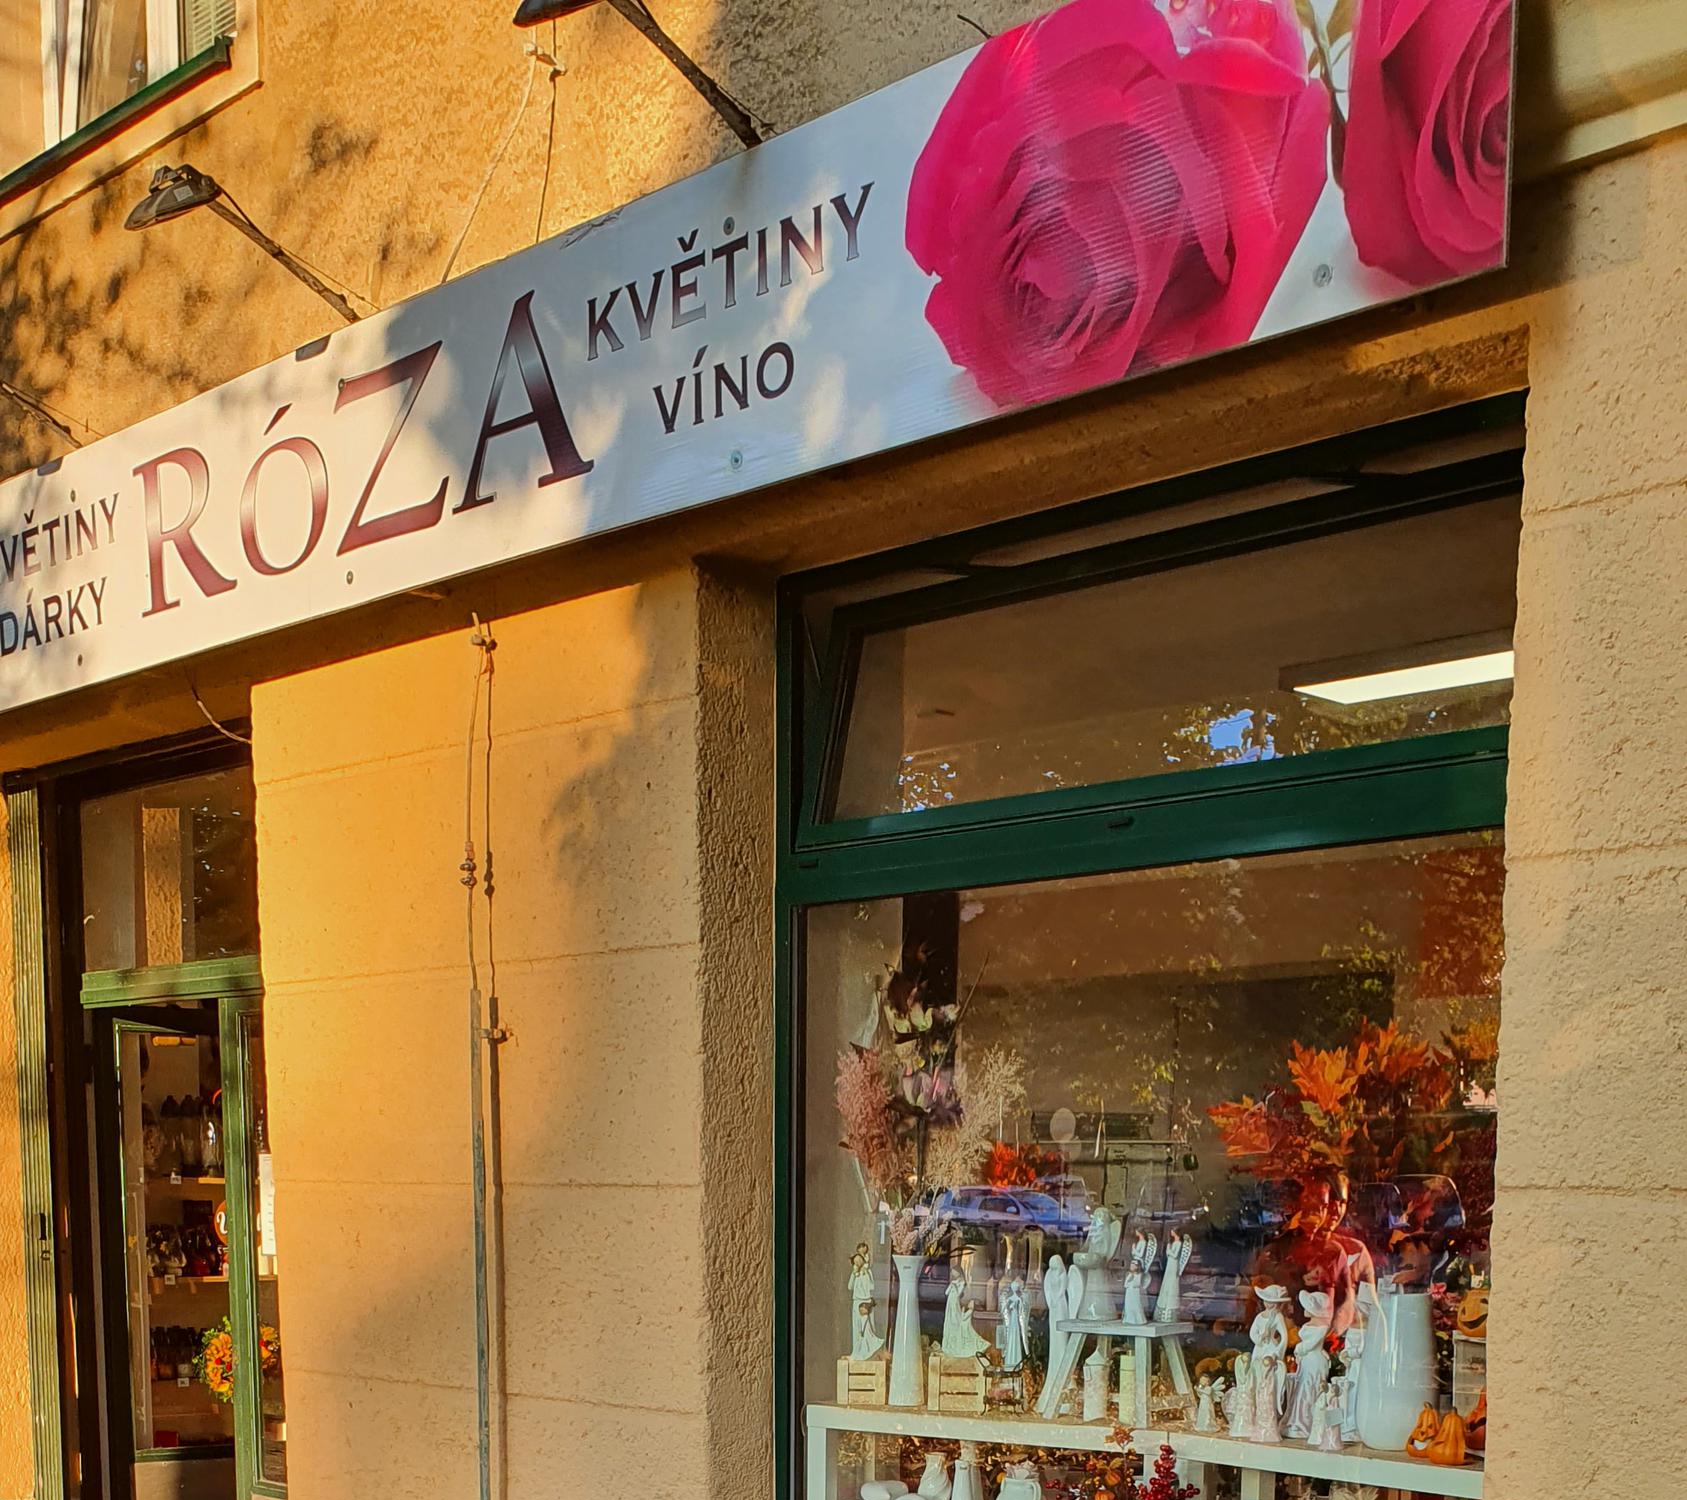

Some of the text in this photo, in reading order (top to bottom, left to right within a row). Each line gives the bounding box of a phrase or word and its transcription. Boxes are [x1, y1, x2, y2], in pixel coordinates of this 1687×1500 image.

[587, 181, 875, 361] KVĚTINY
[132, 289, 595, 618] RÓZA
[653, 345, 794, 434] VÍNO
[0, 576, 108, 657] DÁRKY
